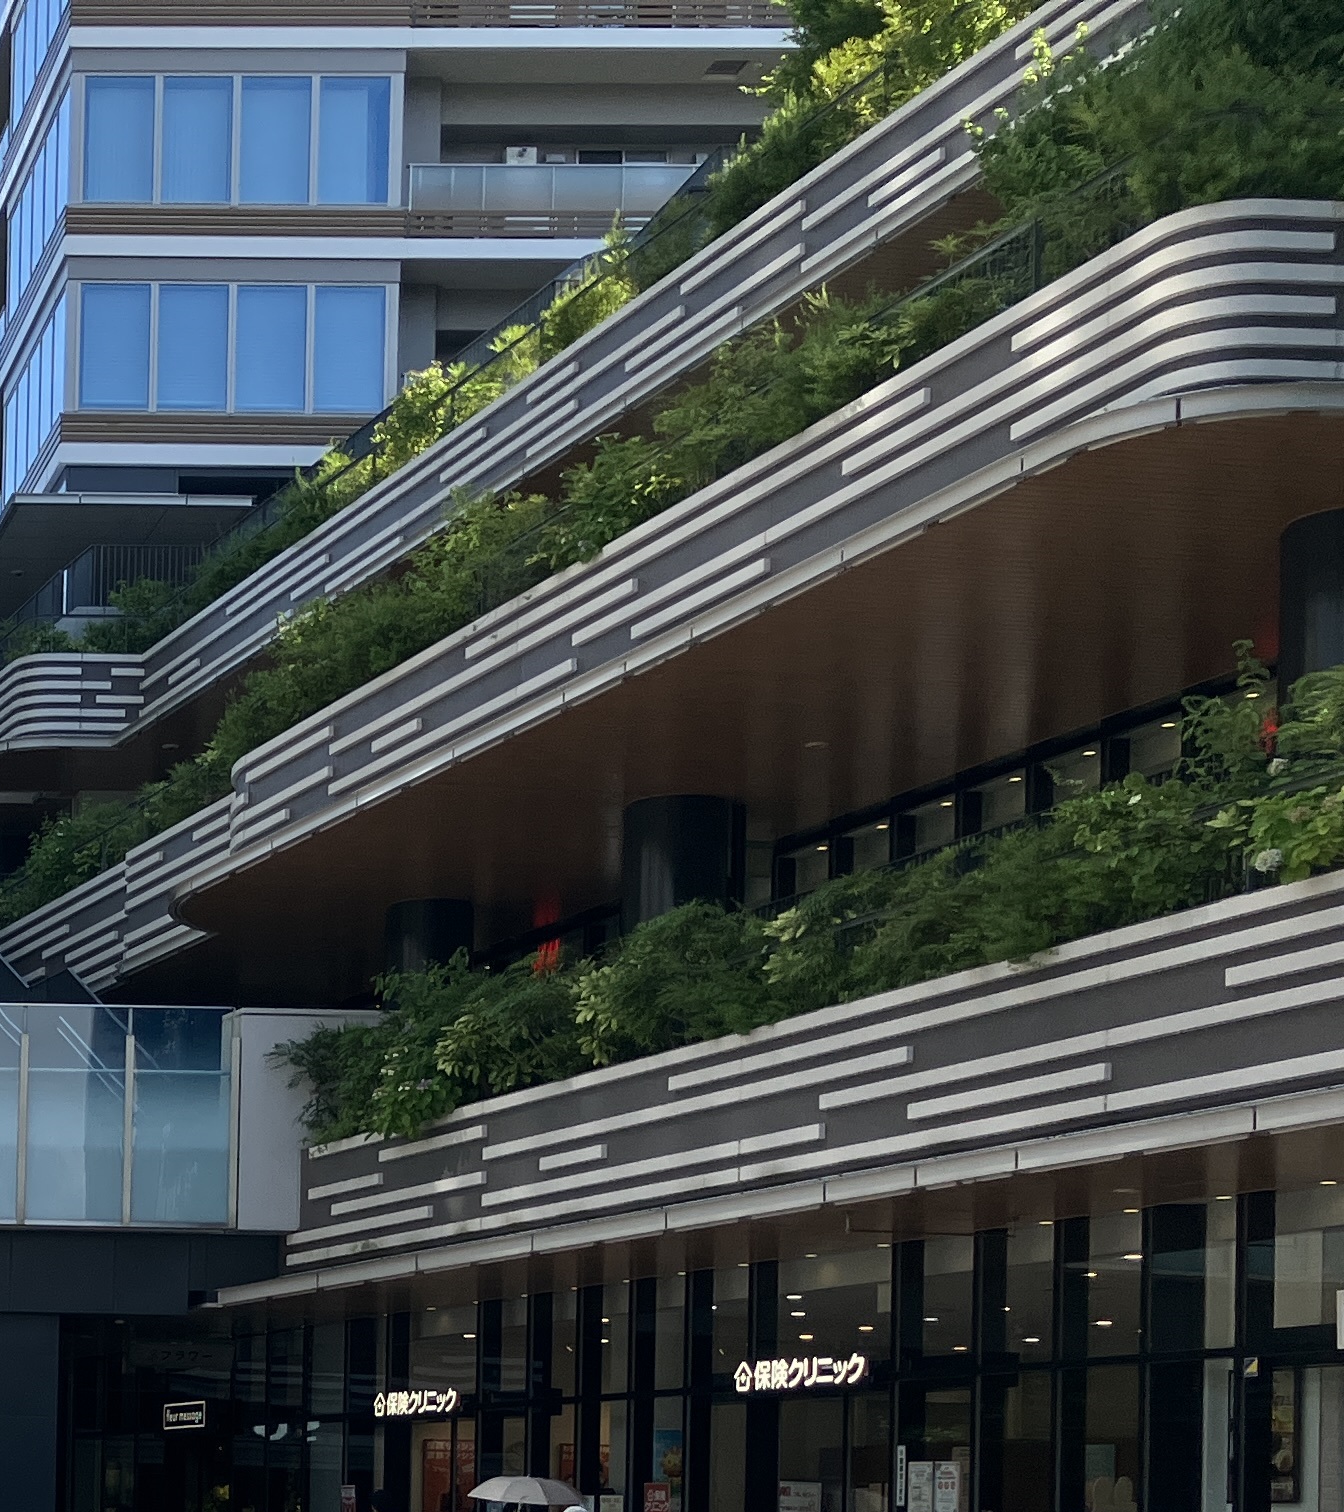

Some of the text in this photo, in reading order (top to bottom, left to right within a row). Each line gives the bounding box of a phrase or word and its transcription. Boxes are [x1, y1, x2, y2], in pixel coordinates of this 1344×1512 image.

[754, 1352, 865, 1391] 保険クリニック
[386, 1387, 457, 1416] 保険クリニック
